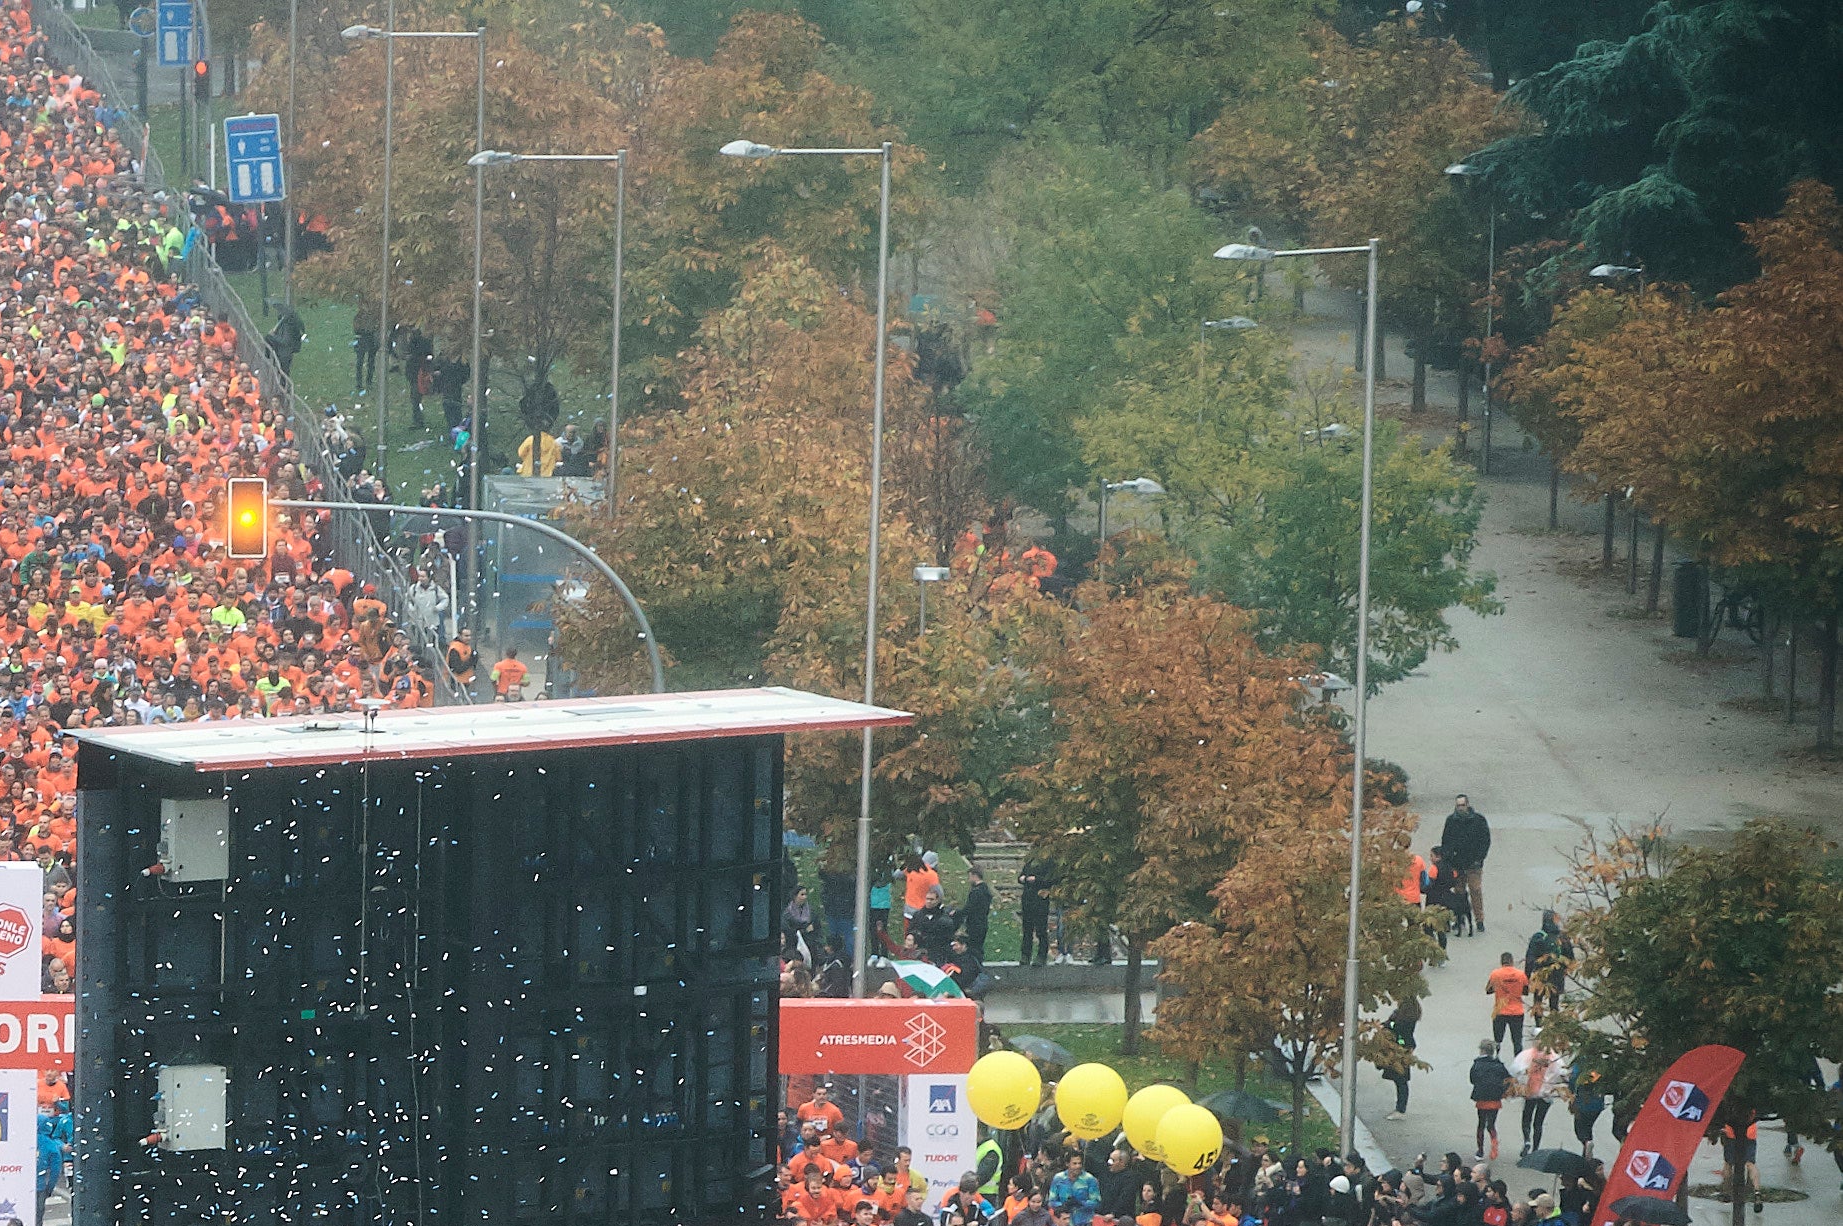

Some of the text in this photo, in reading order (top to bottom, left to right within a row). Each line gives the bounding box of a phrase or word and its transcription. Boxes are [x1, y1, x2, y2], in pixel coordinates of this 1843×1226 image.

[820, 1034, 897, 1046] ATRESMEDIA
[929, 1098, 953, 1111] AXA
[924, 1154, 958, 1162] TUDOR
